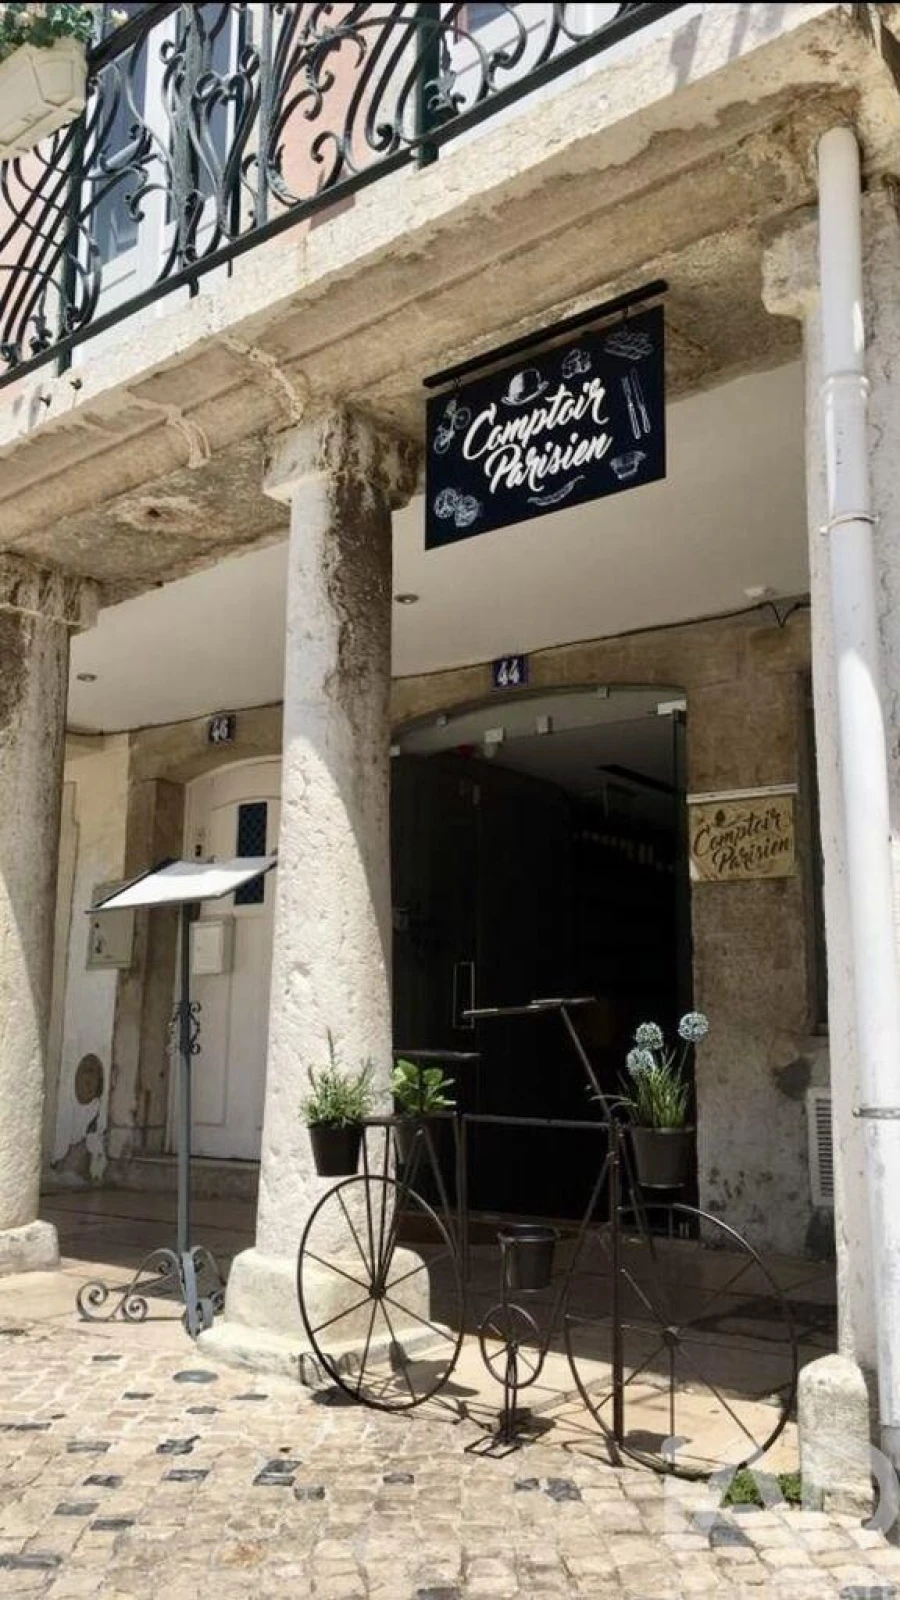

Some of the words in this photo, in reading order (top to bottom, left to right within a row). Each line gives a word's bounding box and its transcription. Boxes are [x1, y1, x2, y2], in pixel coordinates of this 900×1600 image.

[463, 378, 609, 460] Comptoir
[484, 432, 612, 494] Parisien
[497, 659, 520, 685] 44
[212, 718, 228, 742] 46
[693, 808, 785, 857] Comptoir
[711, 837, 789, 873] Parisien
